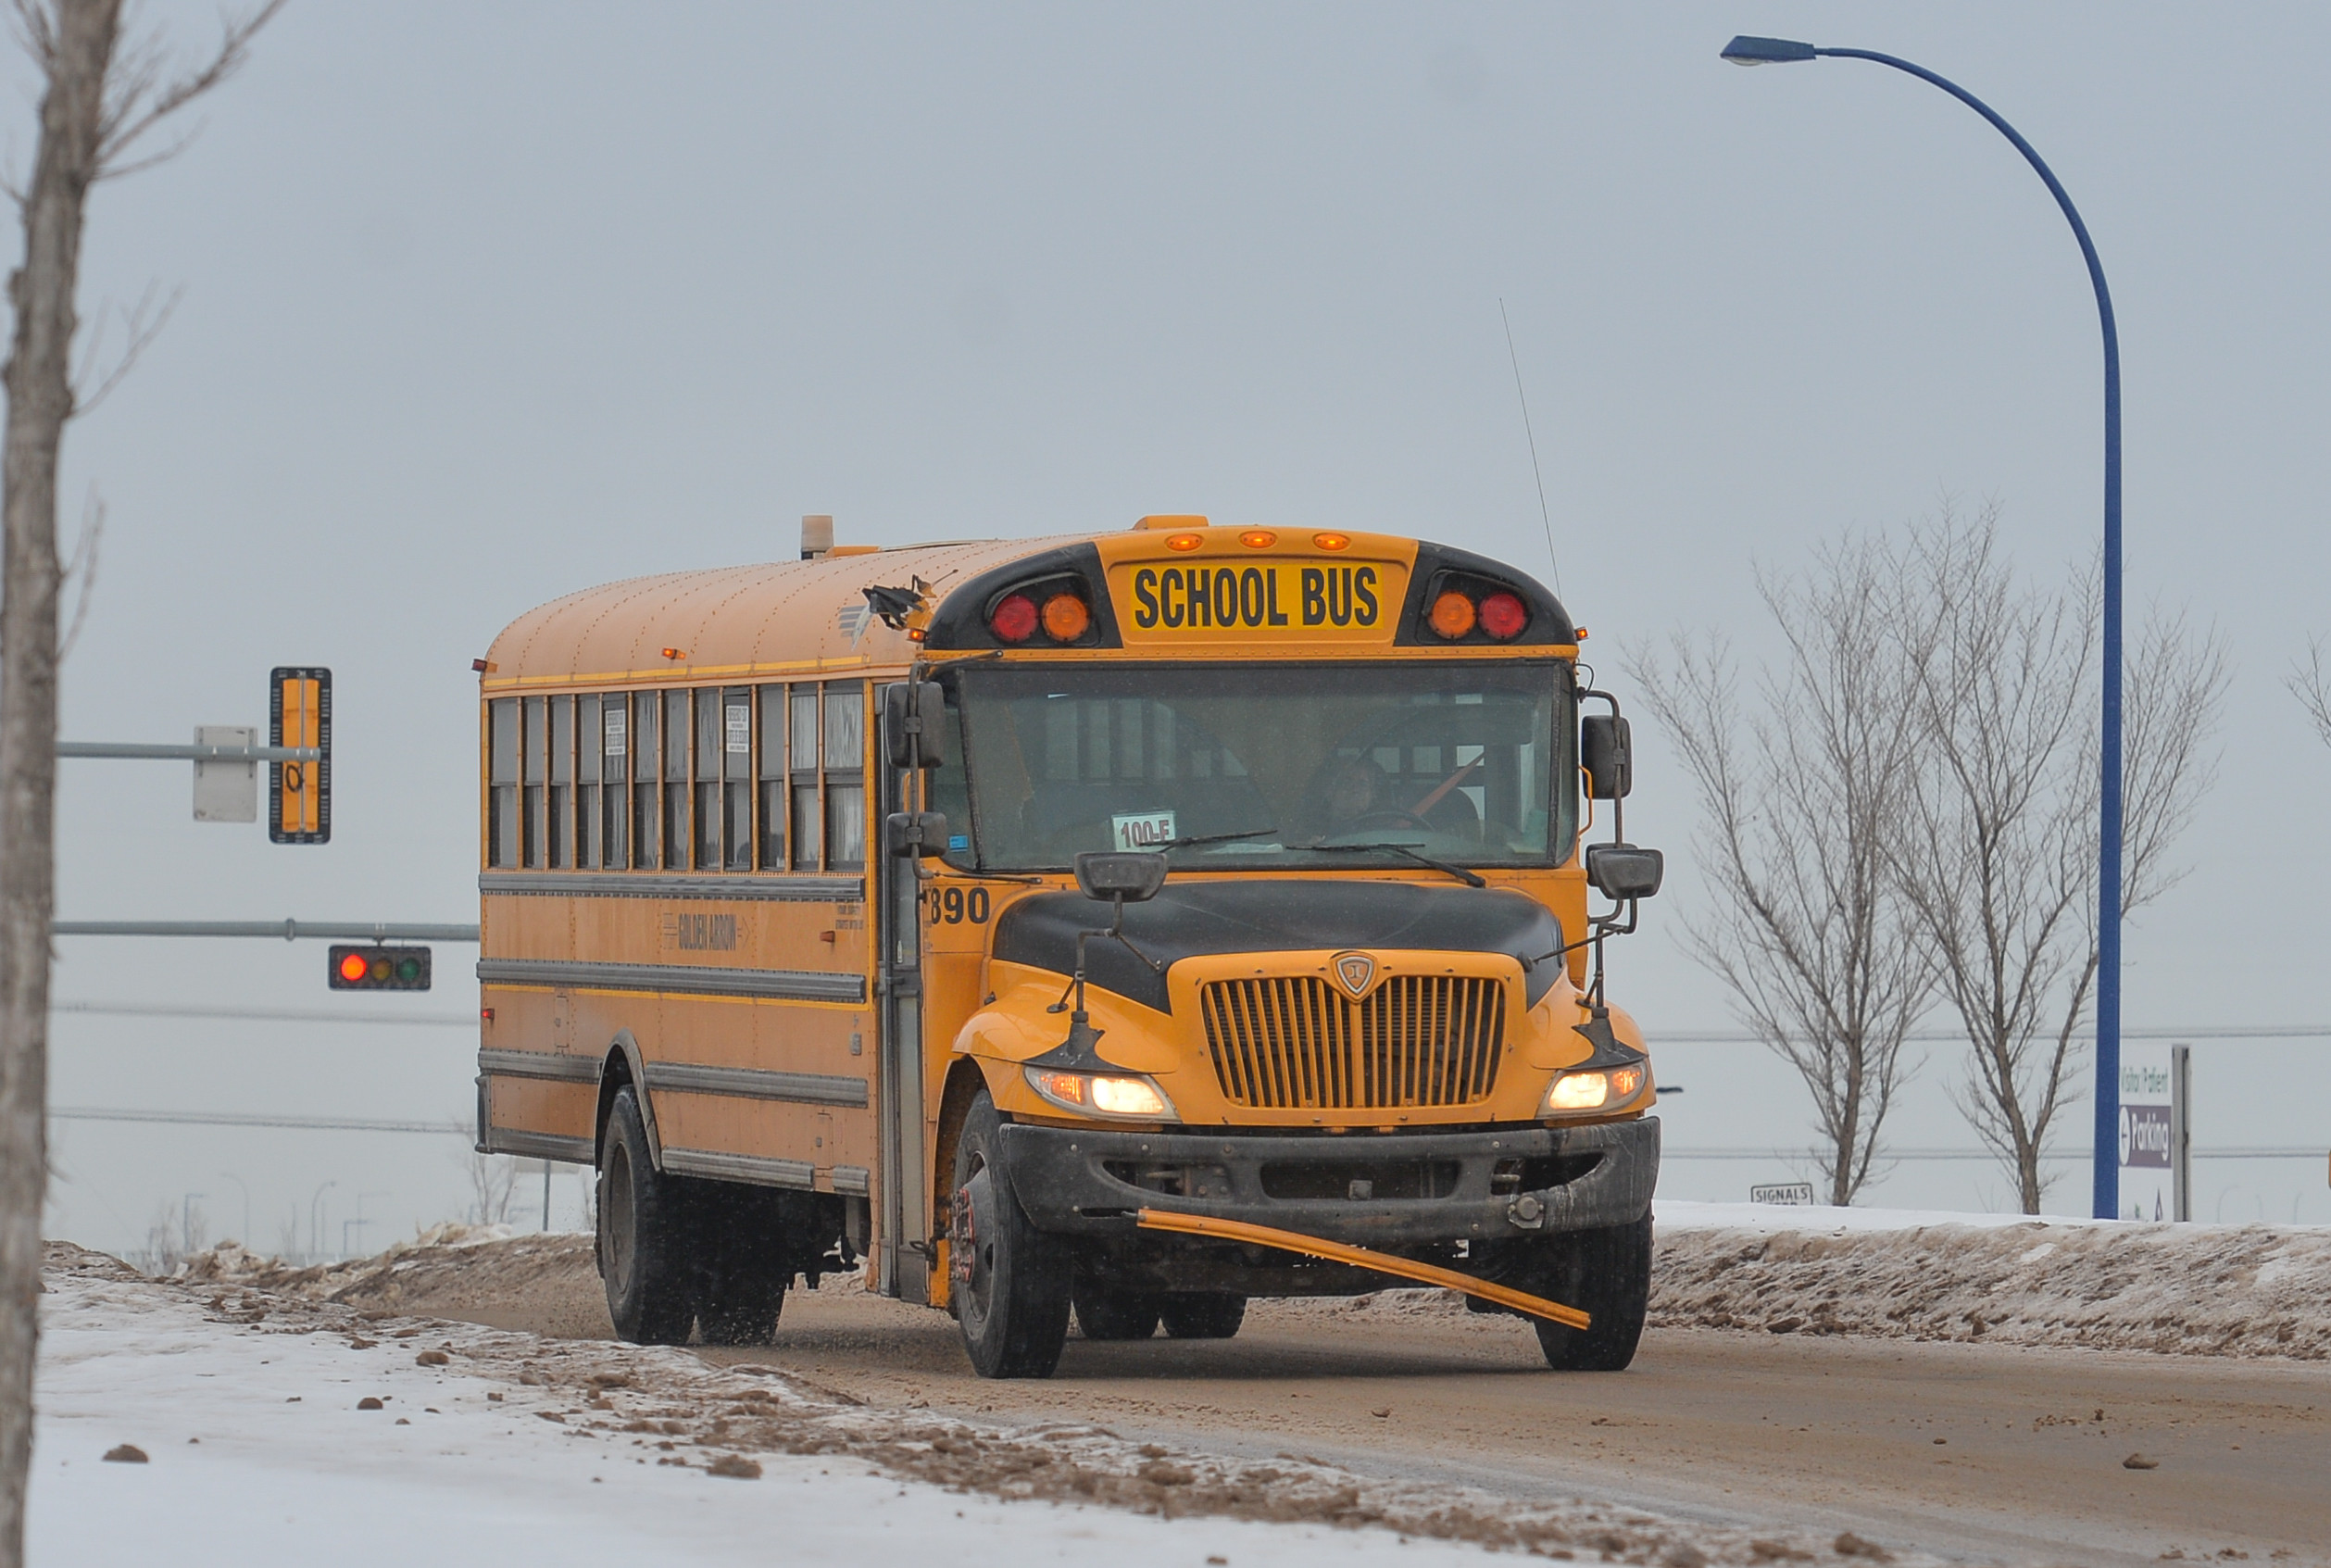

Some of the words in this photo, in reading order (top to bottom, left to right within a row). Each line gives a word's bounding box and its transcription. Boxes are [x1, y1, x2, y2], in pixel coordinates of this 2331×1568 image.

[1134, 567, 1288, 629] SCHOOL
[1301, 567, 1378, 626] BUS
[2132, 1112, 2169, 1161] Parking
[1756, 1186, 1808, 1203] SIGNALS
